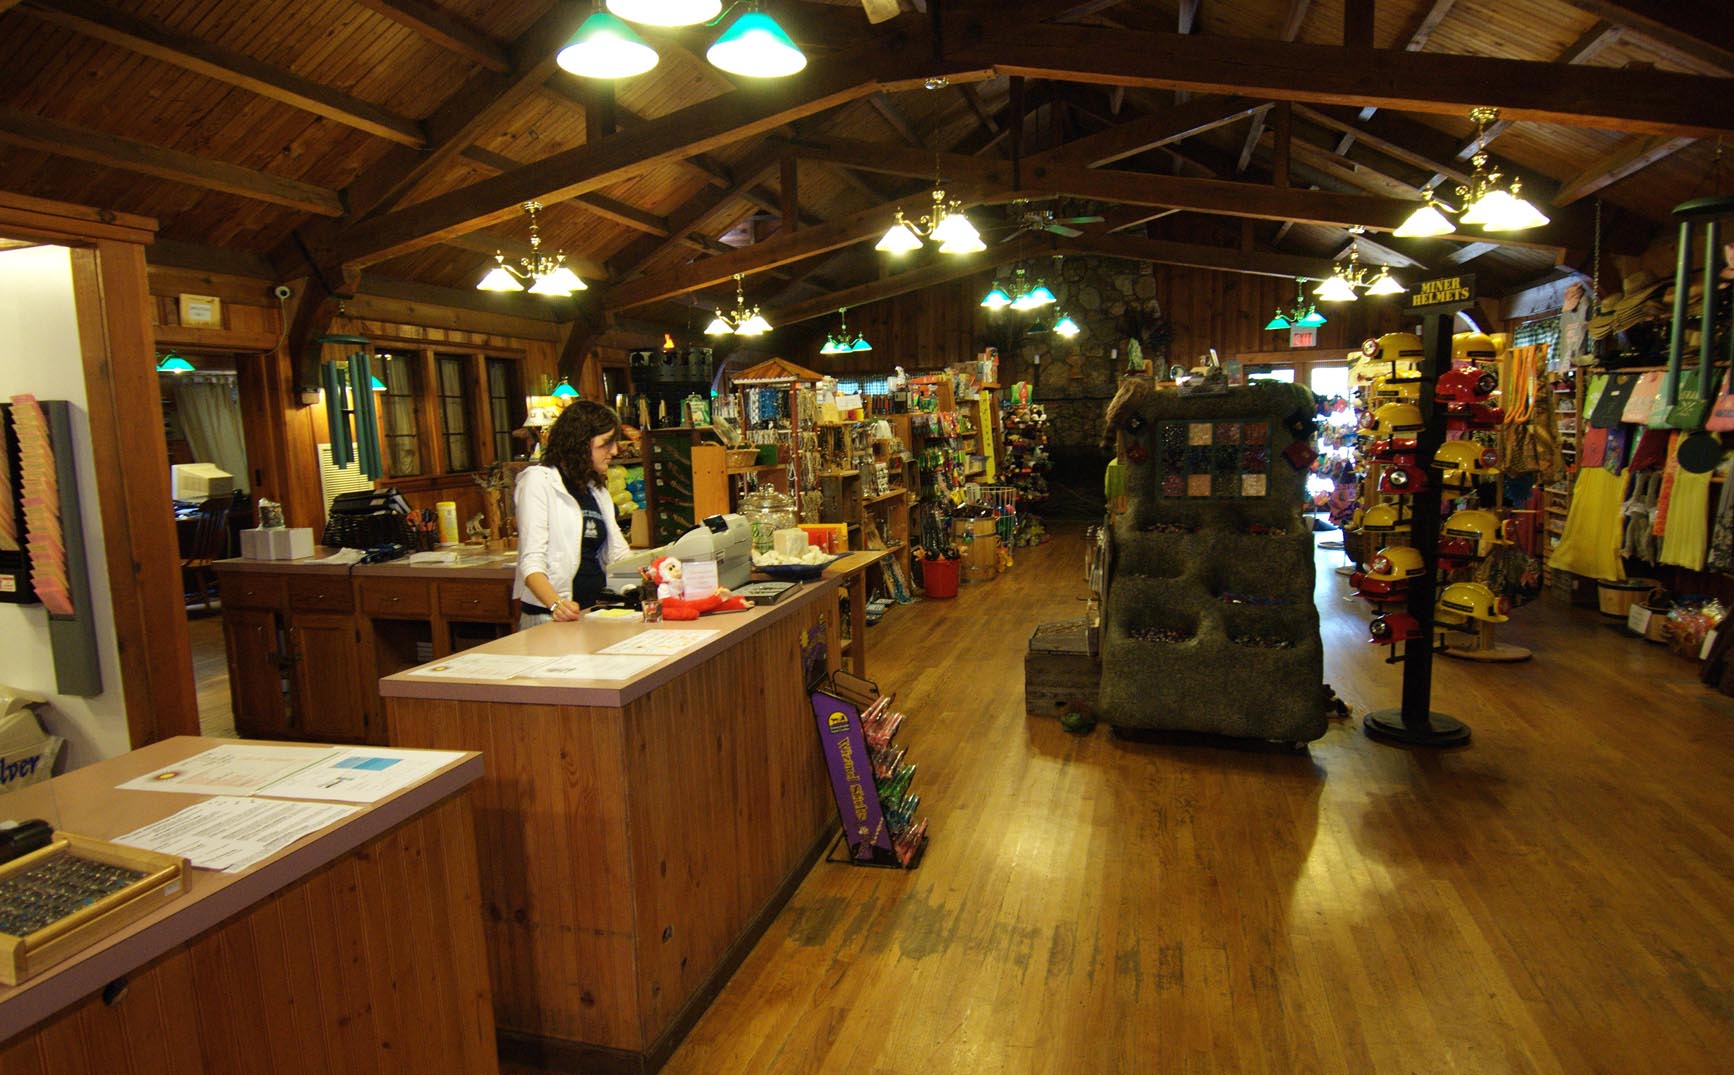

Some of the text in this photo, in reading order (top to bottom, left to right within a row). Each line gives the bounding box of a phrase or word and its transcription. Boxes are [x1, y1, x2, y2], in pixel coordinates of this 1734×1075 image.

[1422, 277, 1460, 293] MINER
[1412, 287, 1470, 306] HELMETS
[1293, 332, 1313, 346] EXIT
[837, 736, 860, 782] Wizard
